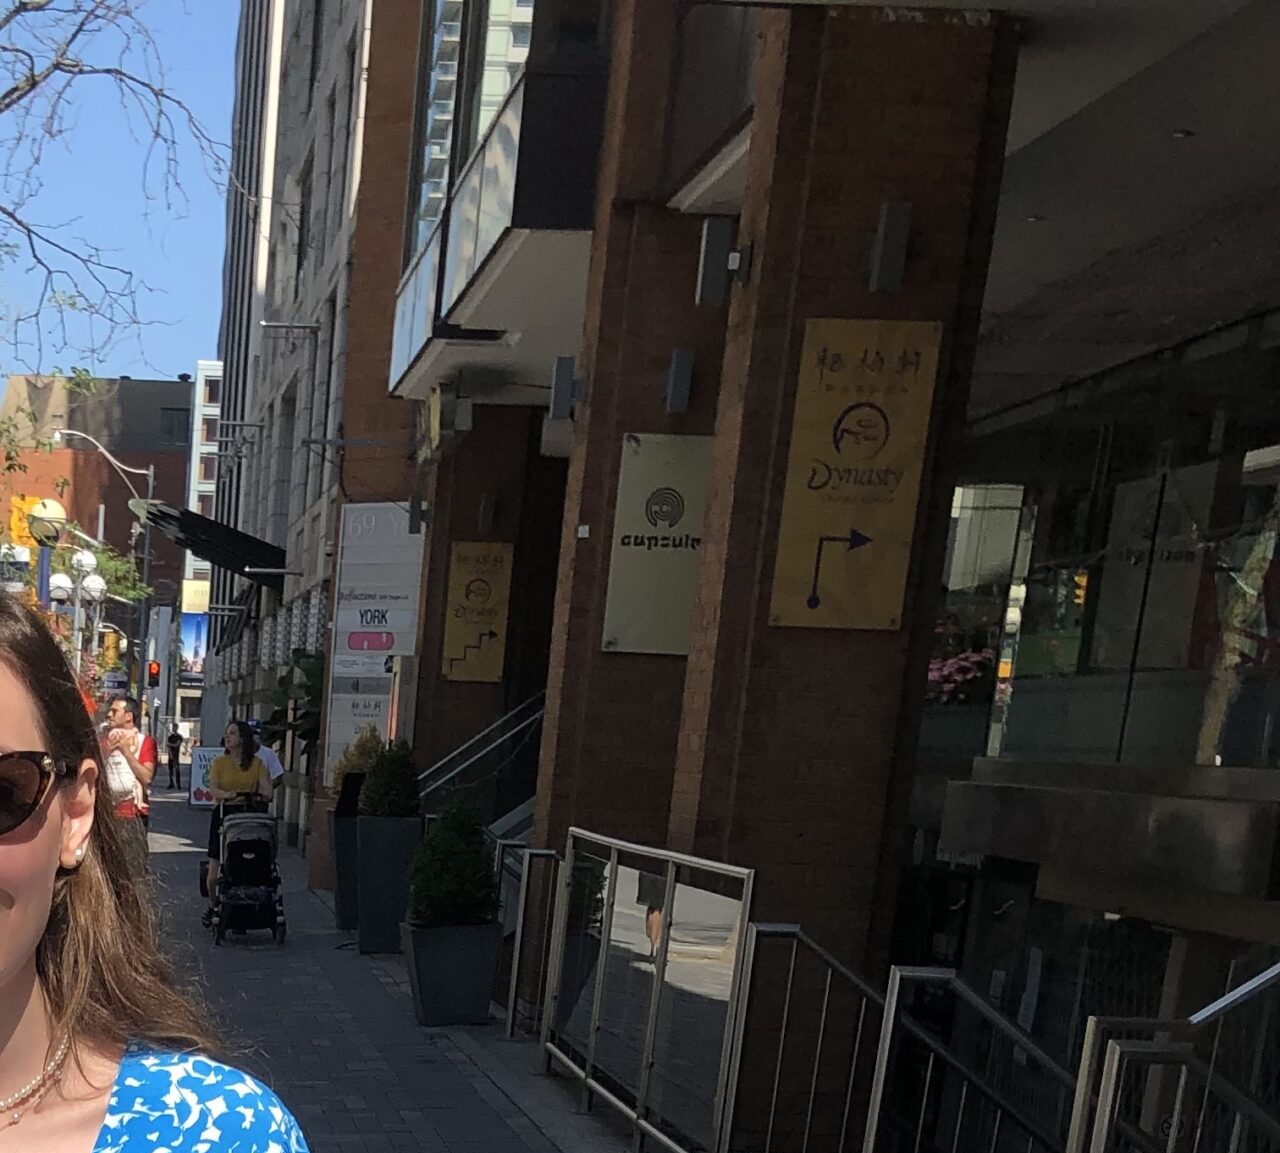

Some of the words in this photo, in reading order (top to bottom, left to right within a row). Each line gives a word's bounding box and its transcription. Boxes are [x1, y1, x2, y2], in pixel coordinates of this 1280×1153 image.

[808, 458, 904, 494] Dynasty
[350, 513, 376, 537] 69
[359, 609, 389, 624] YORK
